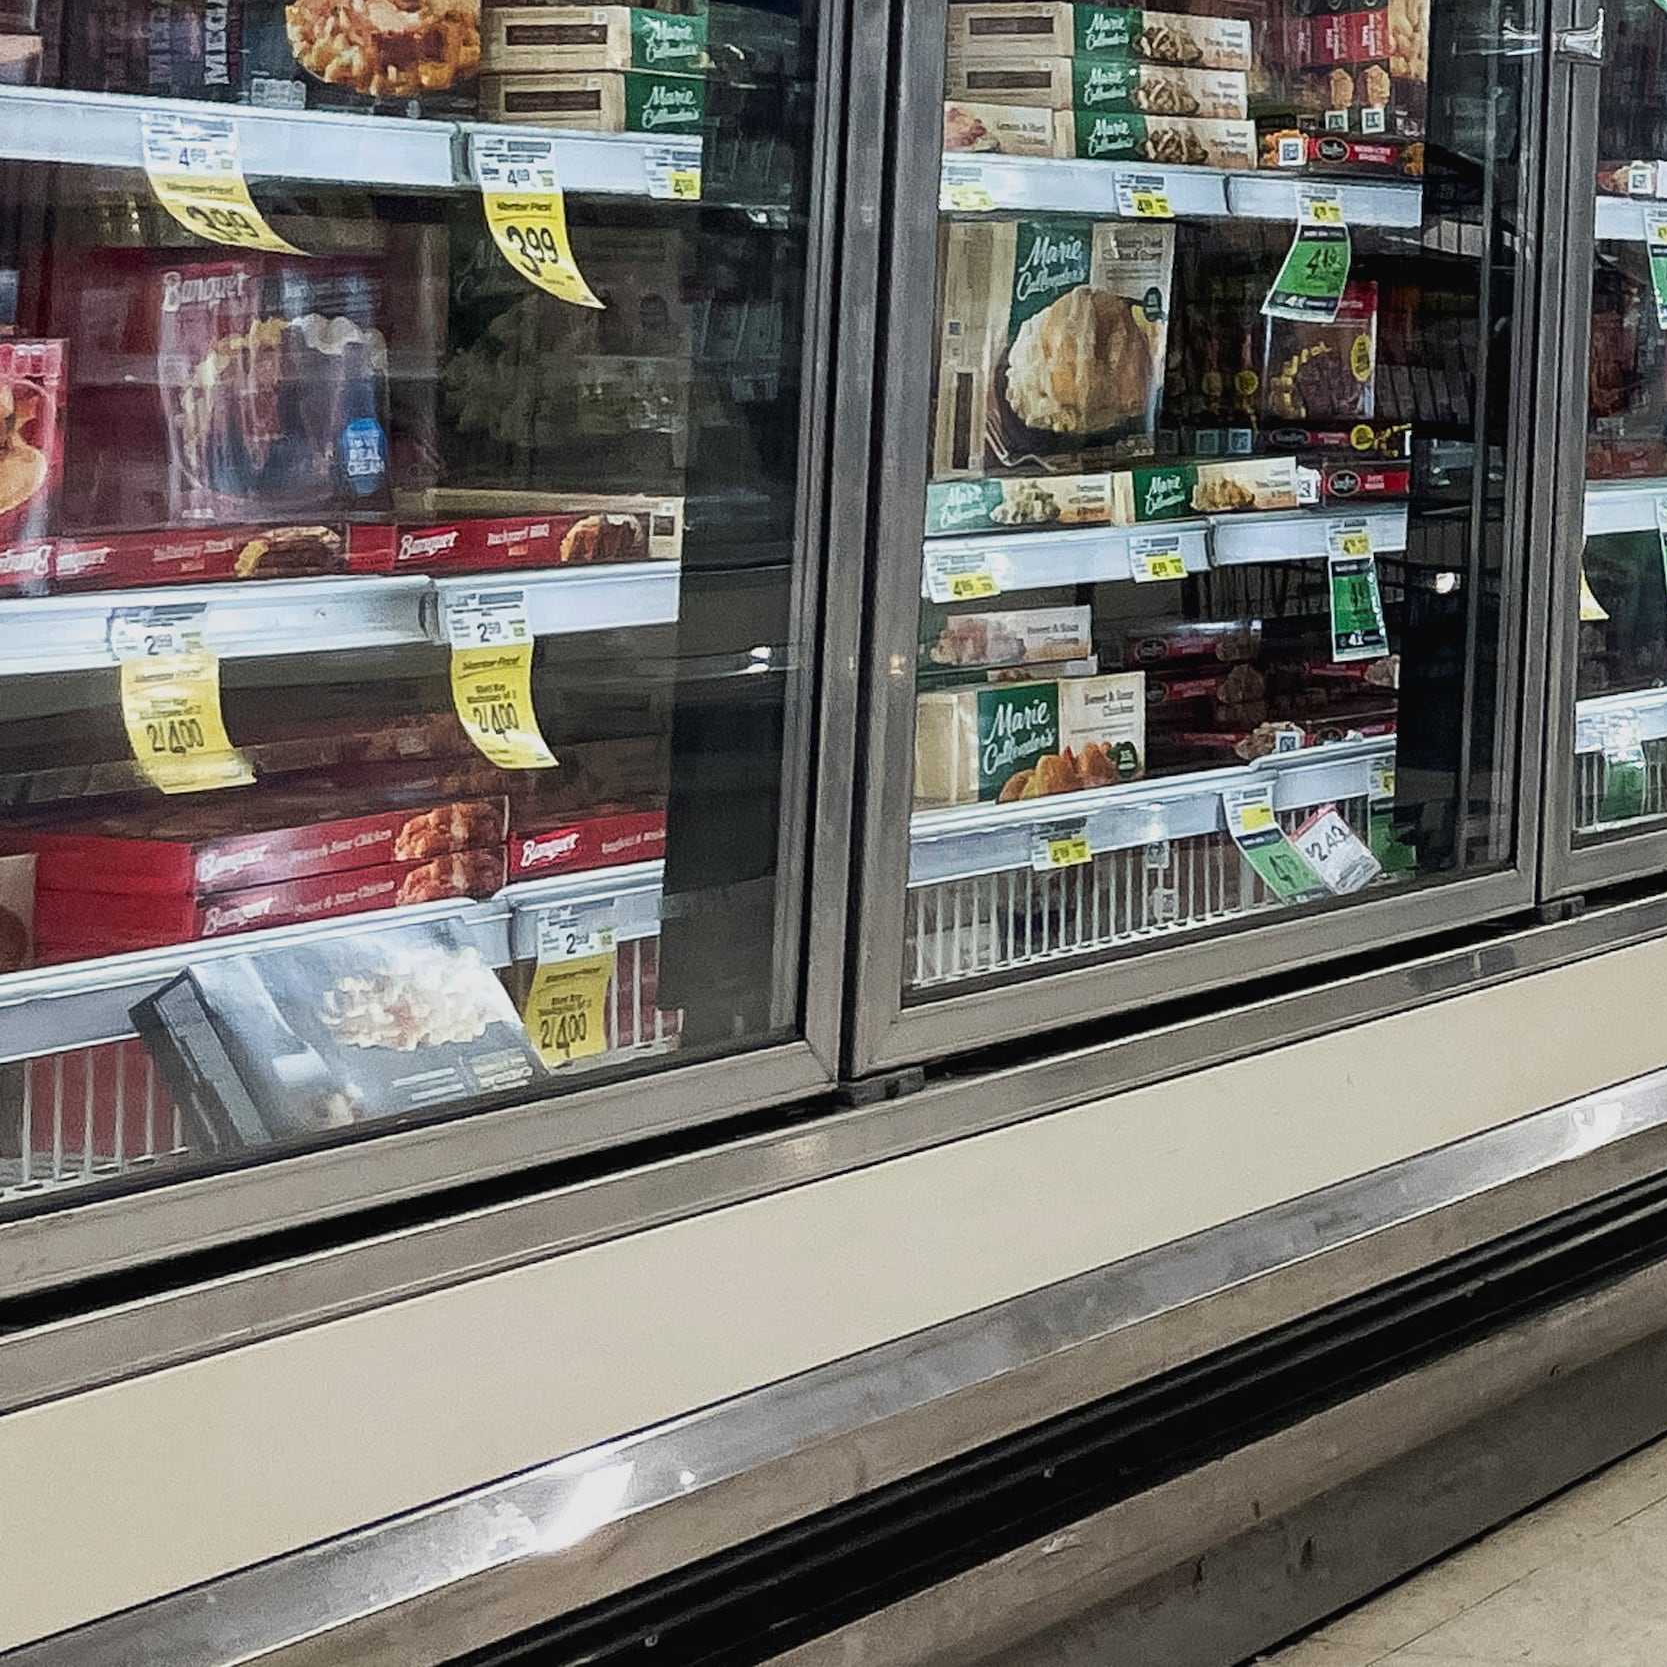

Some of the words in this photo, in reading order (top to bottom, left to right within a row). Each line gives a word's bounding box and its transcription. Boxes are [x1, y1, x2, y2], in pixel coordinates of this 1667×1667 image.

[641, 85, 696, 112] Marie
[1017, 235, 1084, 273] Marie
[1016, 266, 1087, 302] Callender's
[980, 699, 1050, 746] Marie
[982, 727, 1057, 775] Callender's
[520, 831, 581, 868] Banquet
